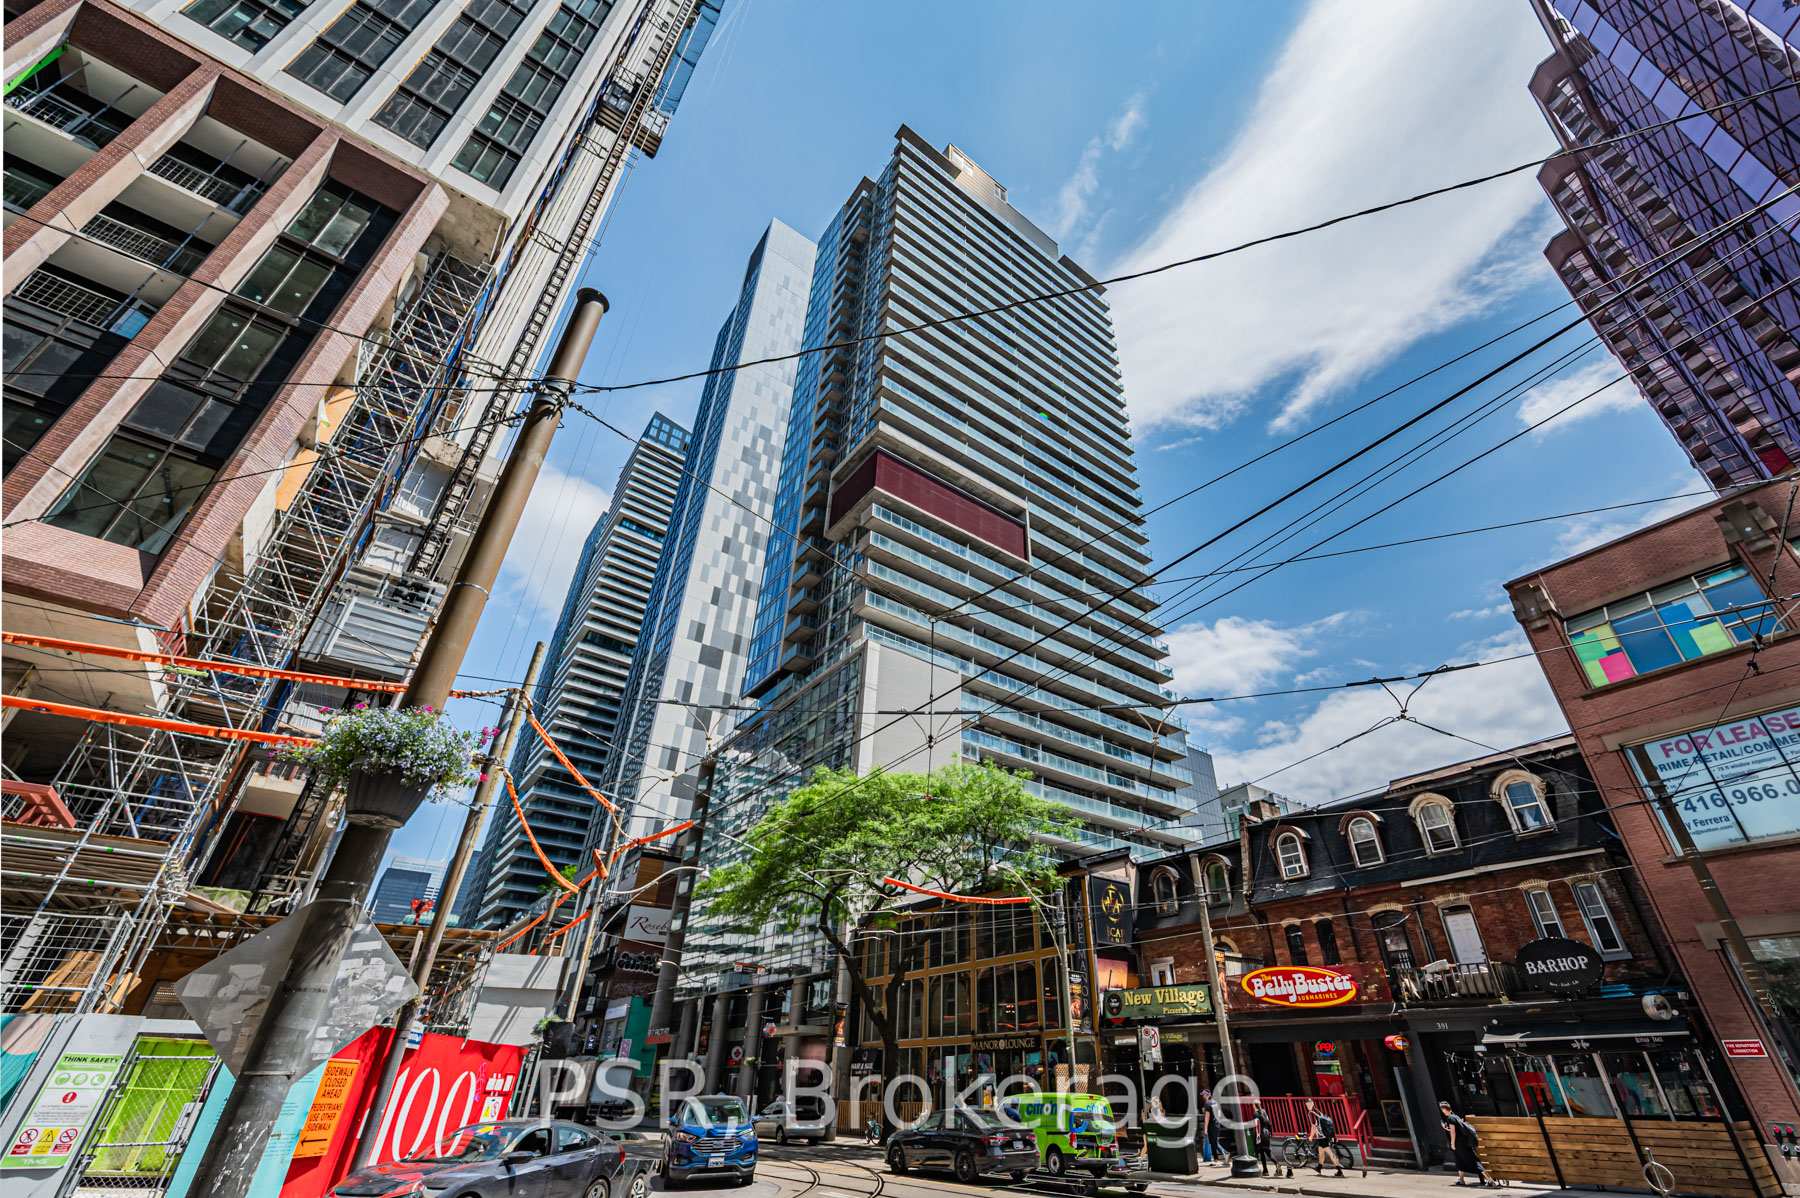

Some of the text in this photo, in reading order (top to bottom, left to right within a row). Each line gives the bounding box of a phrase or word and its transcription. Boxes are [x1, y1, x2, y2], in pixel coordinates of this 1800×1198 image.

[1660, 711, 1800, 759] FOR LEASE
[1658, 733, 1800, 773] RIME RETAIL/COMME
[1694, 814, 1730, 828] Ferrera
[1525, 955, 1588, 975] BARHOP
[1124, 991, 1152, 1006] New
[1154, 988, 1205, 1008] Village
[1006, 1038, 1035, 1049] LOUNGE
[326, 1066, 354, 1077] SIDEWALK
[321, 1088, 342, 1099] AHEAD
